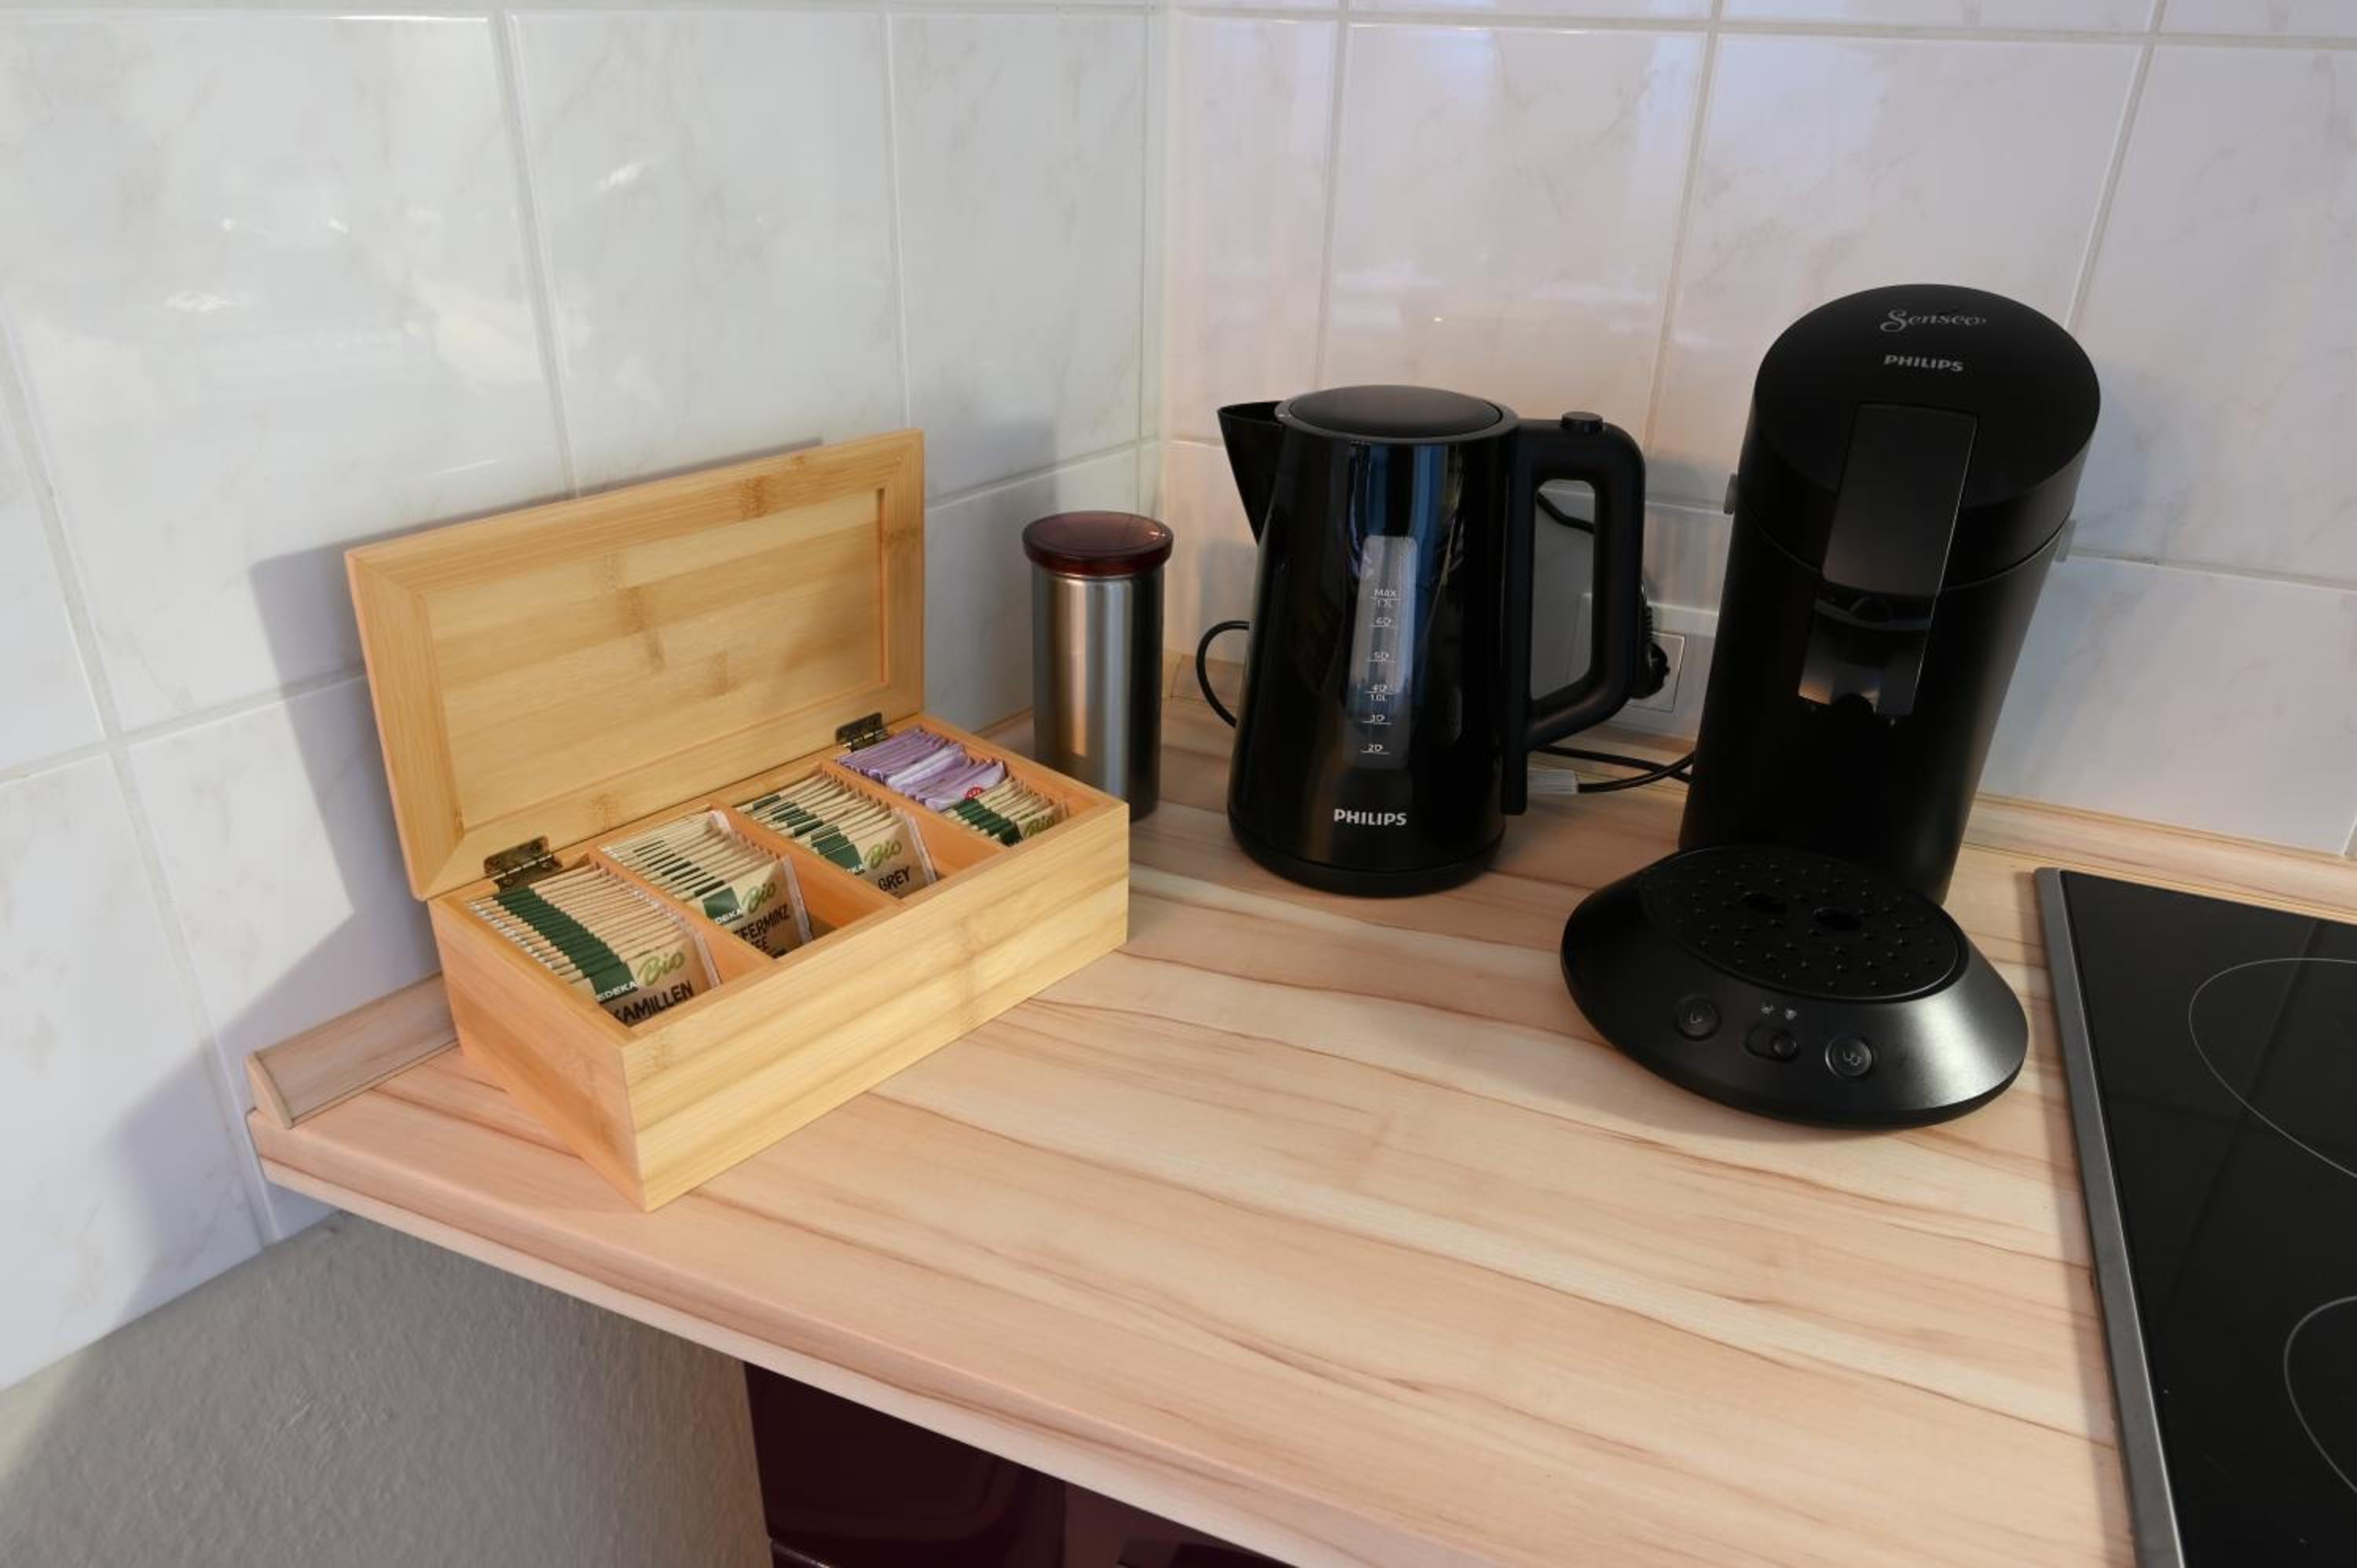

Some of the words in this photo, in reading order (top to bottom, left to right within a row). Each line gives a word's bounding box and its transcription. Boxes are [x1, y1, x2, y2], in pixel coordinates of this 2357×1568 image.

[1879, 310, 1987, 332] Senseo
[1882, 354, 1964, 372] PHILIPS
[1333, 808, 1408, 826] PHILIPS
[864, 840, 903, 869] Bio
[878, 865, 910, 892] GREY
[742, 881, 776, 914] Bio
[715, 908, 742, 925] DEKA
[637, 951, 685, 987] Bio
